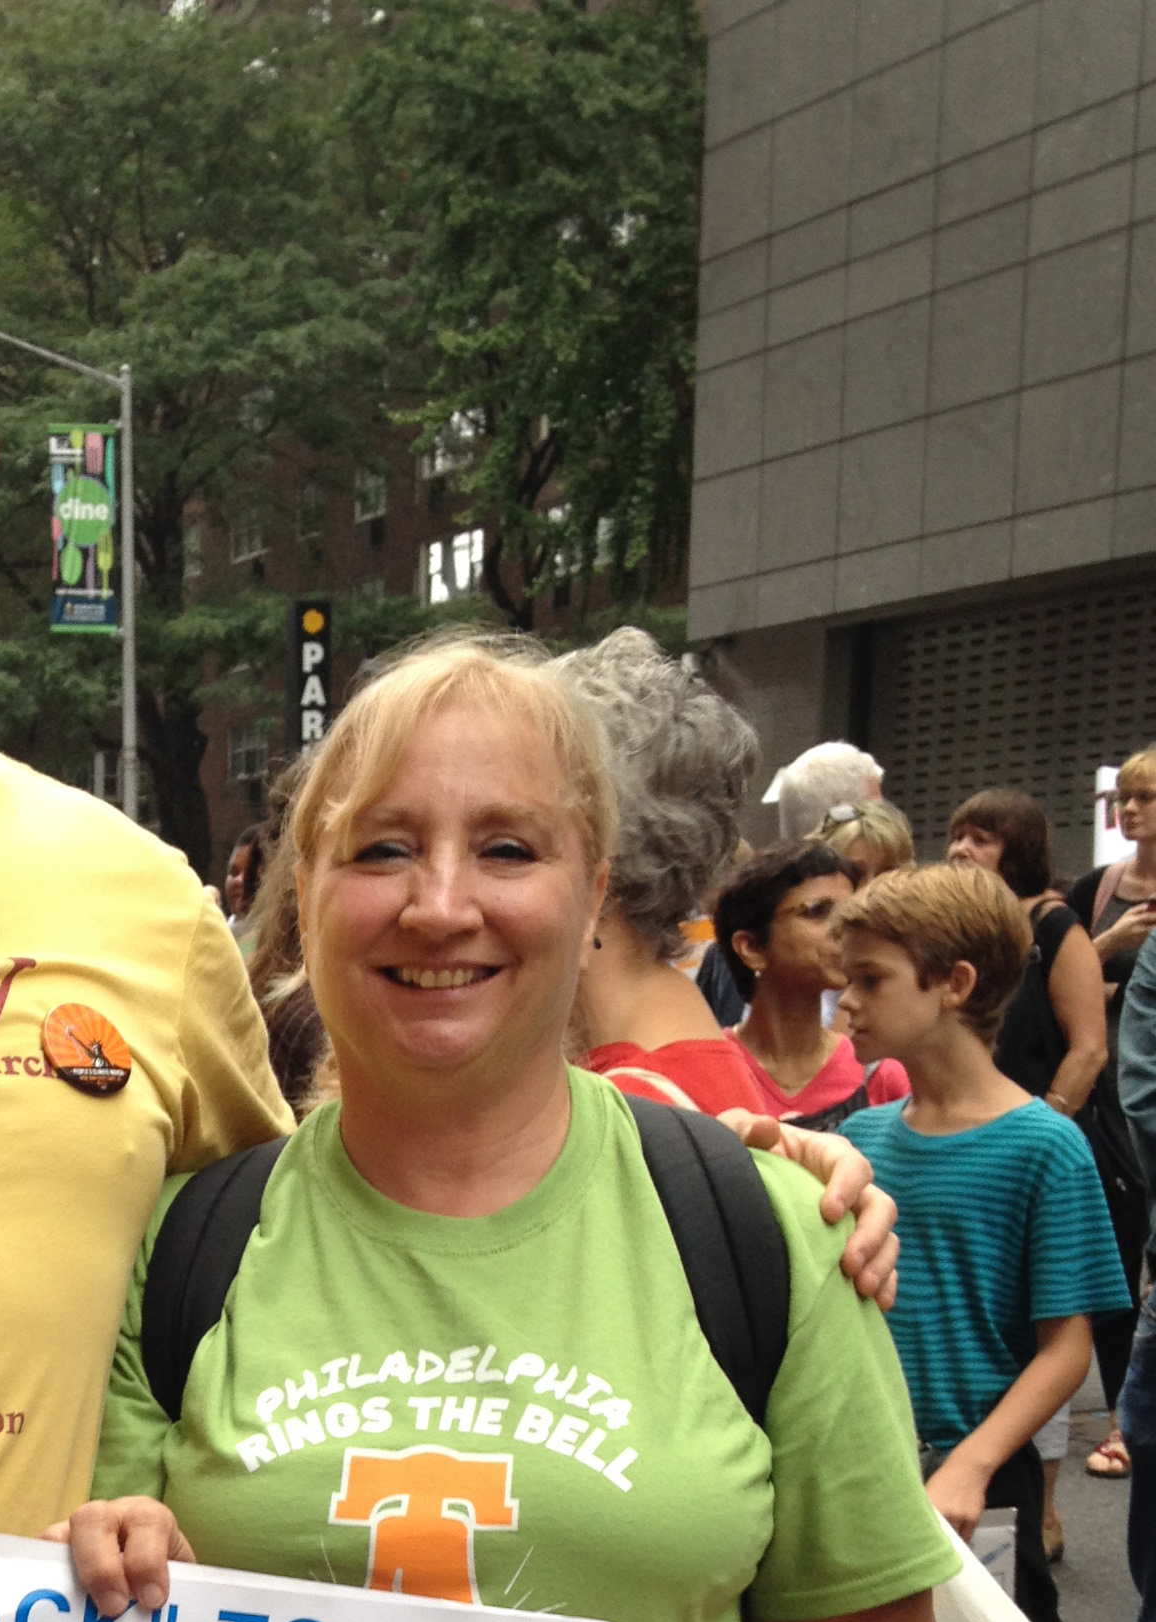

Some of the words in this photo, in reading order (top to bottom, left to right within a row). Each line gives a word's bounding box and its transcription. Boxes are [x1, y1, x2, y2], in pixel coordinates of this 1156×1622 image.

[58, 497, 110, 521] dine
[300, 641, 327, 757] PAR
[255, 1344, 630, 1430] PHILADELPHIA
[235, 1397, 393, 1473] RINGS
[407, 1396, 510, 1436] THE
[513, 1403, 640, 1493] BELL
